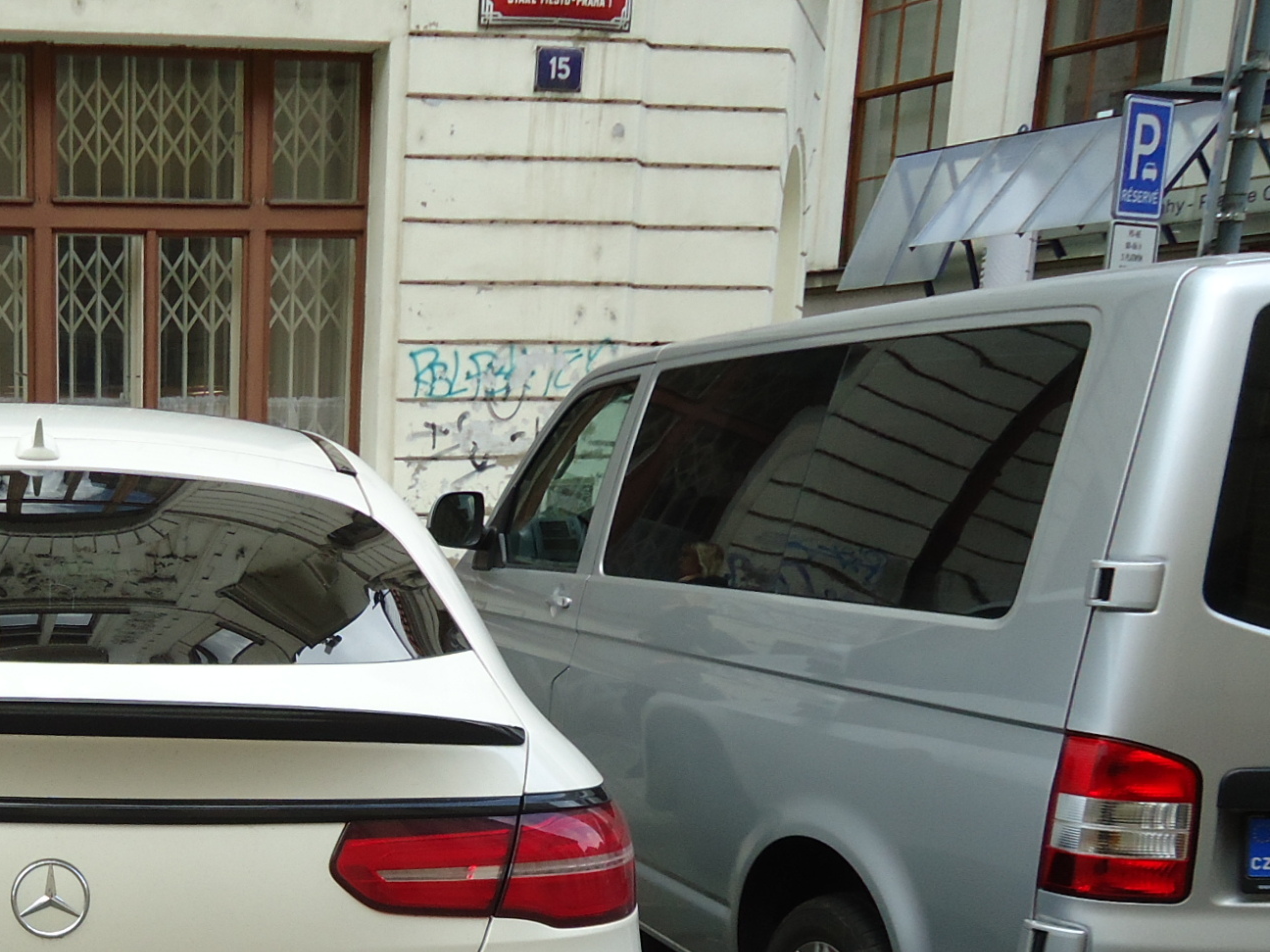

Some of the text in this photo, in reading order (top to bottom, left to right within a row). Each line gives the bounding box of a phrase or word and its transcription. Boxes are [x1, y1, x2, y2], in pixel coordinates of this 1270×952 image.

[549, 56, 571, 80] 15
[1129, 113, 1161, 180] P
[1121, 186, 1159, 205] RÉSERVÉ
[1251, 856, 1270, 871] CZ
